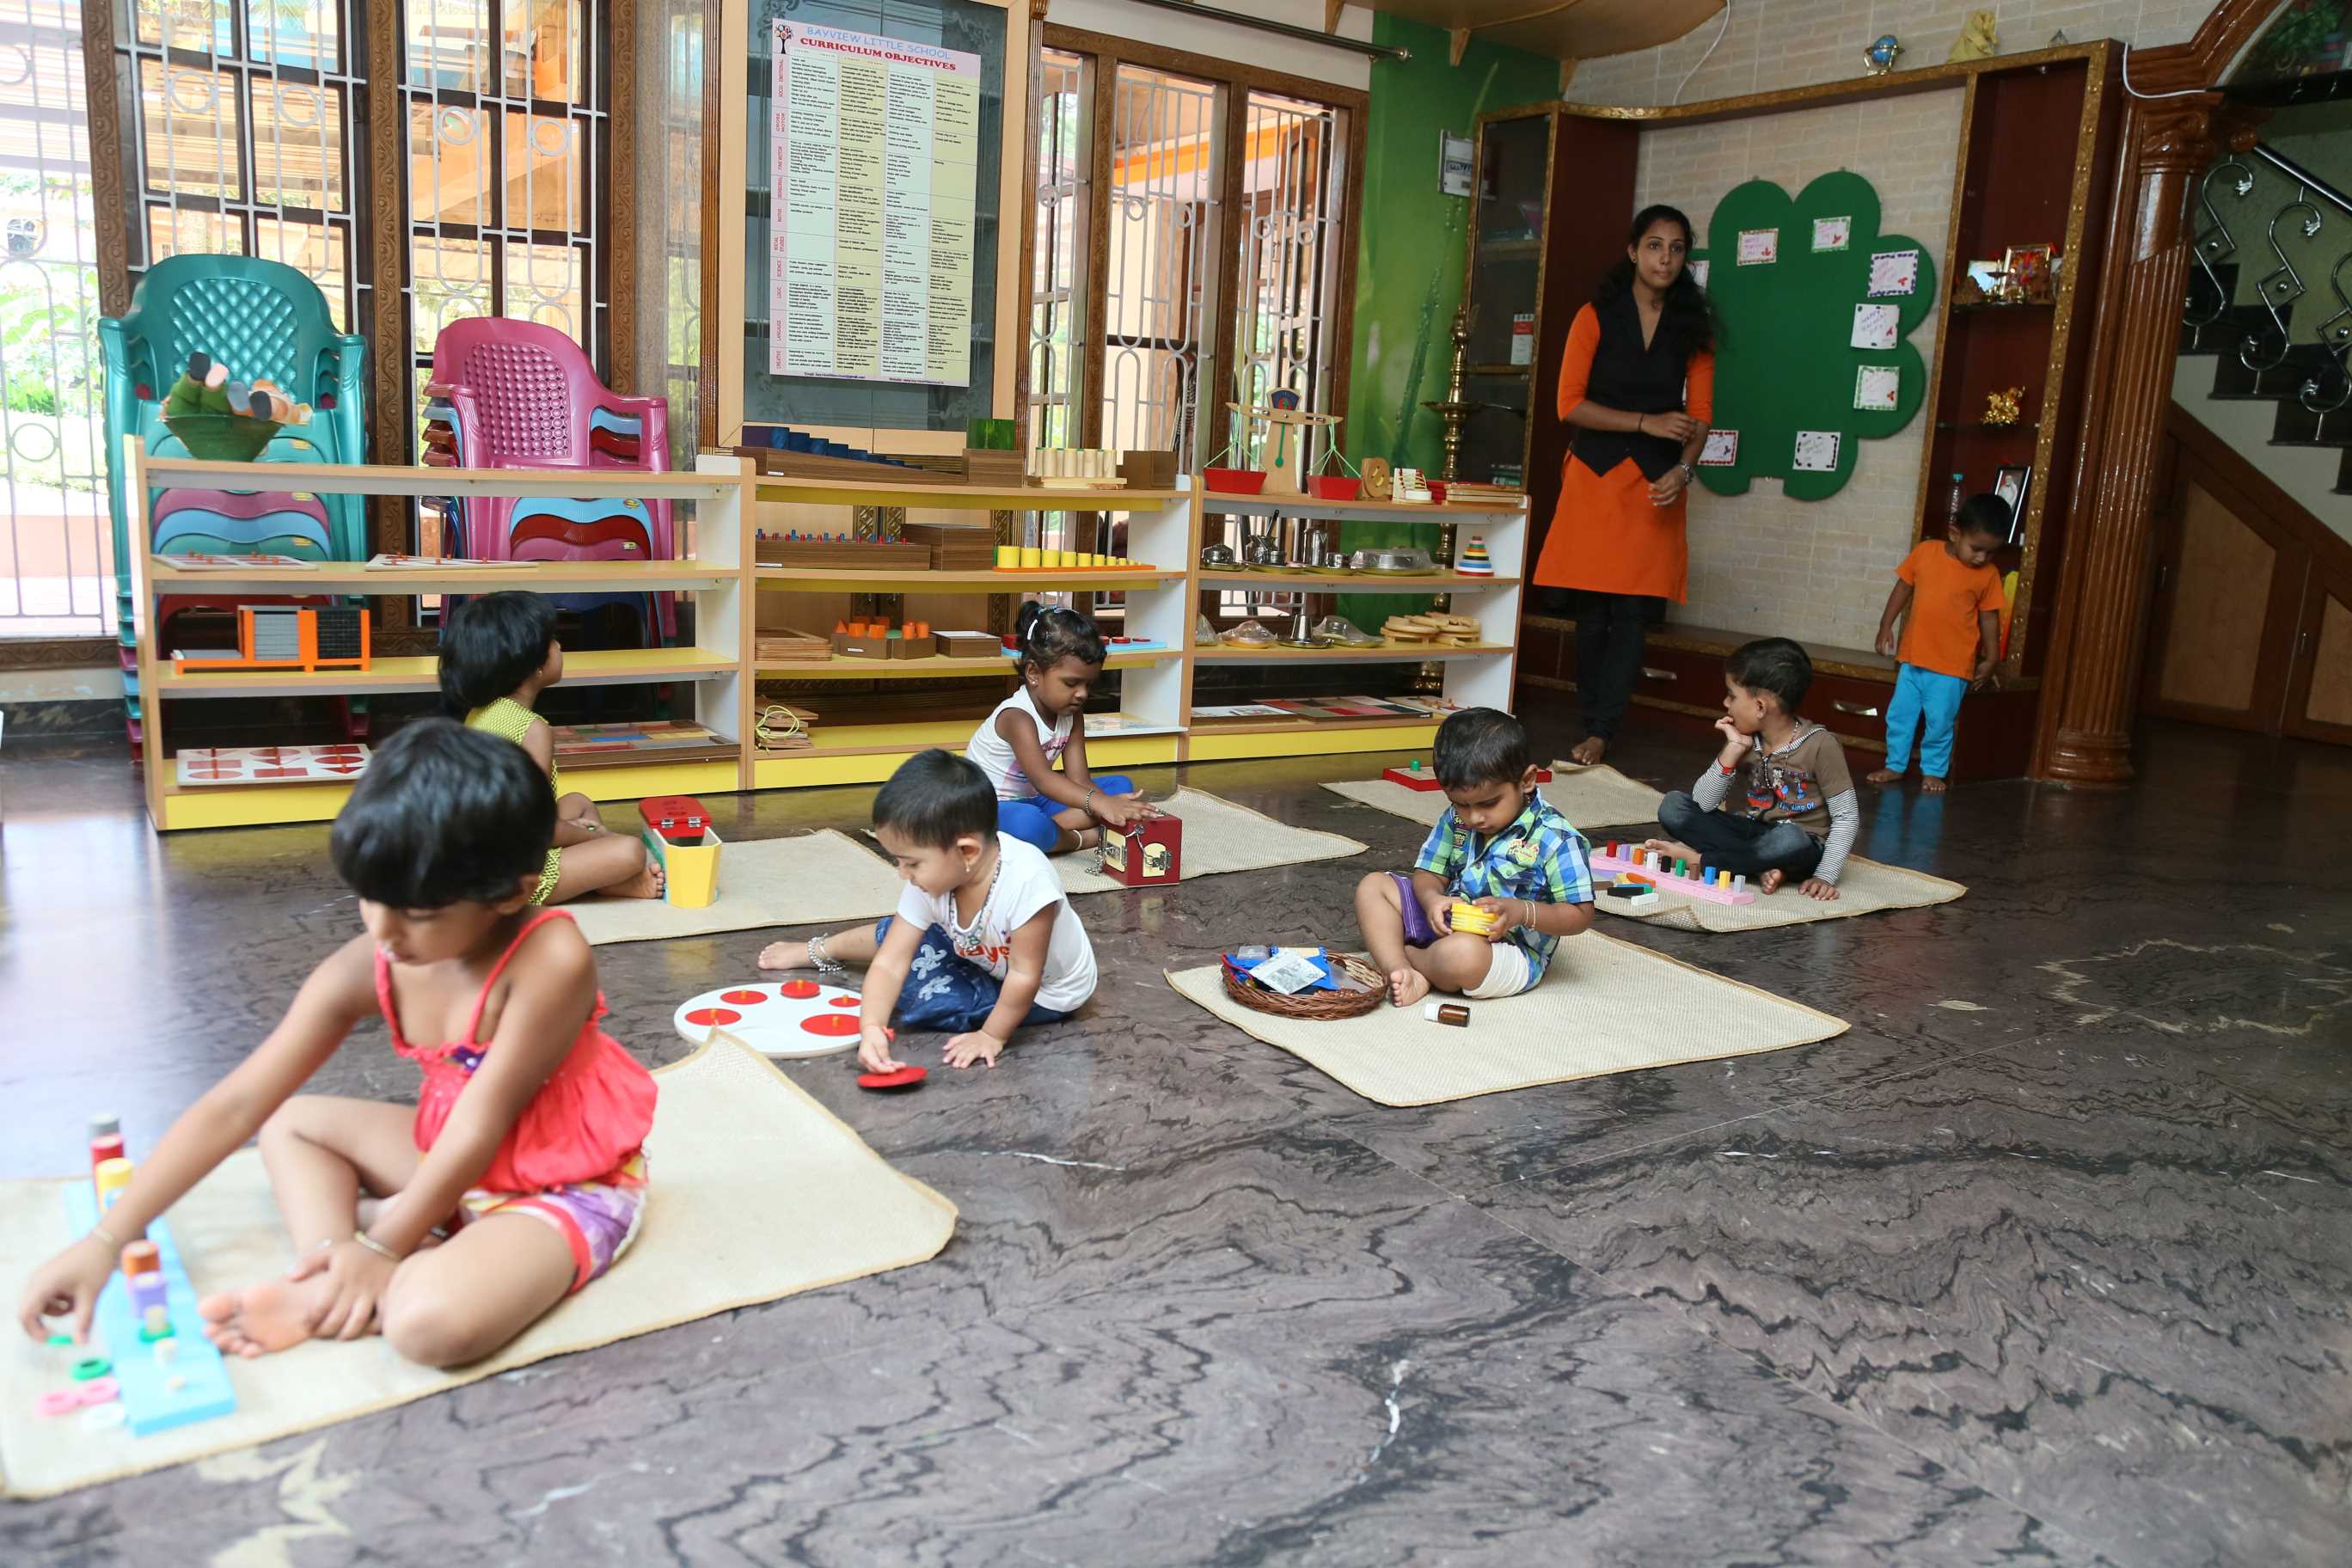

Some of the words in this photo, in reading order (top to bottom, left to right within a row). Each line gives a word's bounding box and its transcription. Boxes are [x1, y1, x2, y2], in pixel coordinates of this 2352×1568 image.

[800, 38, 882, 58] CURRICULUM
[884, 52, 957, 70] OBJECTIVES
[807, 27, 861, 42] BAYVIEW
[865, 38, 903, 50] LITTLE
[908, 46, 950, 59] SCHOOL
